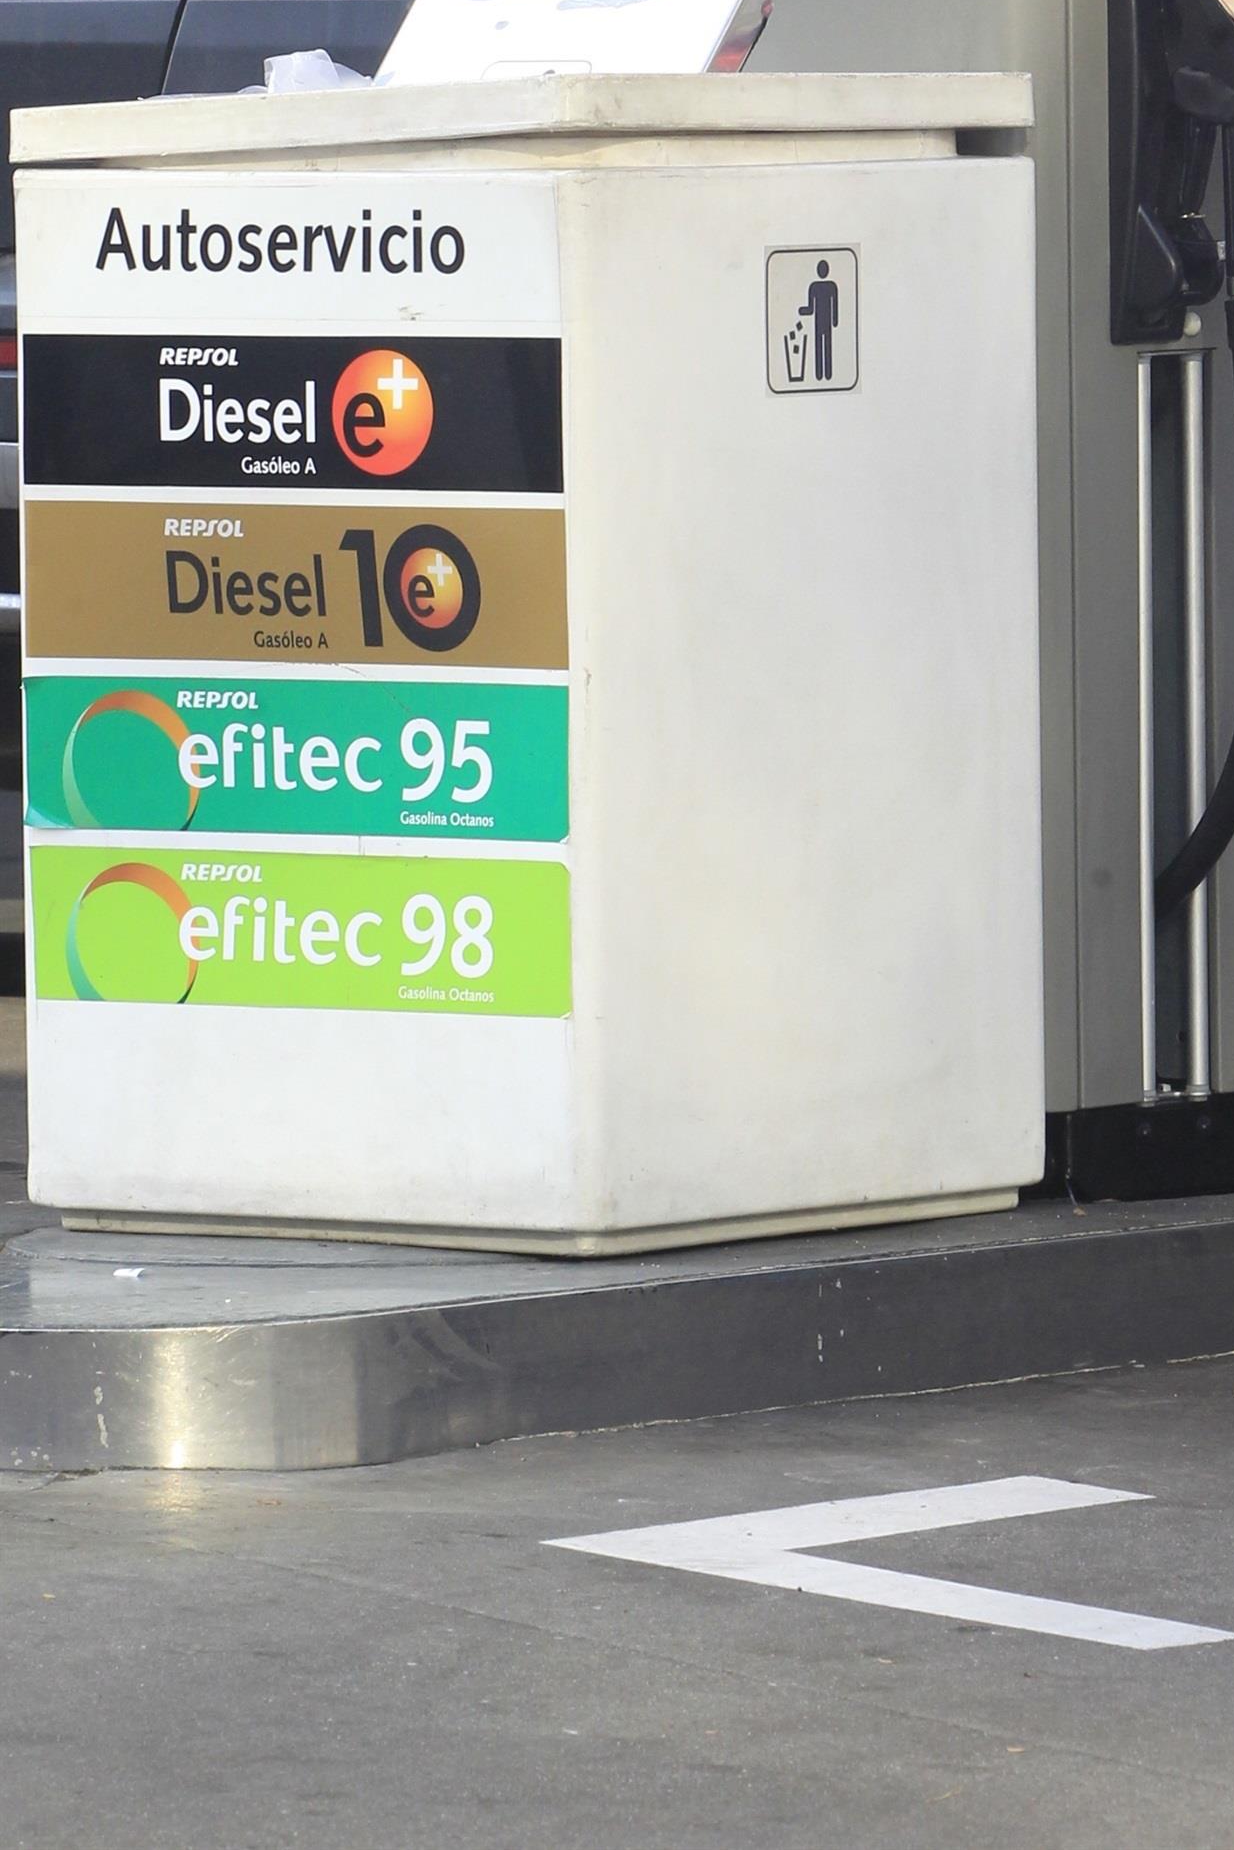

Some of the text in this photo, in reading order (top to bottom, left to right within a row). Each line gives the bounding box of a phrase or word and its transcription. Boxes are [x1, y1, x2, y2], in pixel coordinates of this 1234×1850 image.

[95, 207, 466, 275] Autoservicio
[159, 346, 239, 367] REPSOL
[159, 377, 317, 444] Diesel
[241, 455, 317, 476] Gasóleo A
[164, 518, 245, 538] REPSOL
[165, 549, 328, 618] Diesel
[254, 630, 329, 650] Gasóleo A
[176, 690, 259, 710] REPSOL
[178, 717, 494, 804] efitec 95
[400, 811, 495, 828] Gasolina Octanos
[180, 863, 263, 884] REPSOL
[178, 893, 495, 979] efitec 98
[398, 985, 495, 1004] Gasolina Octanos
